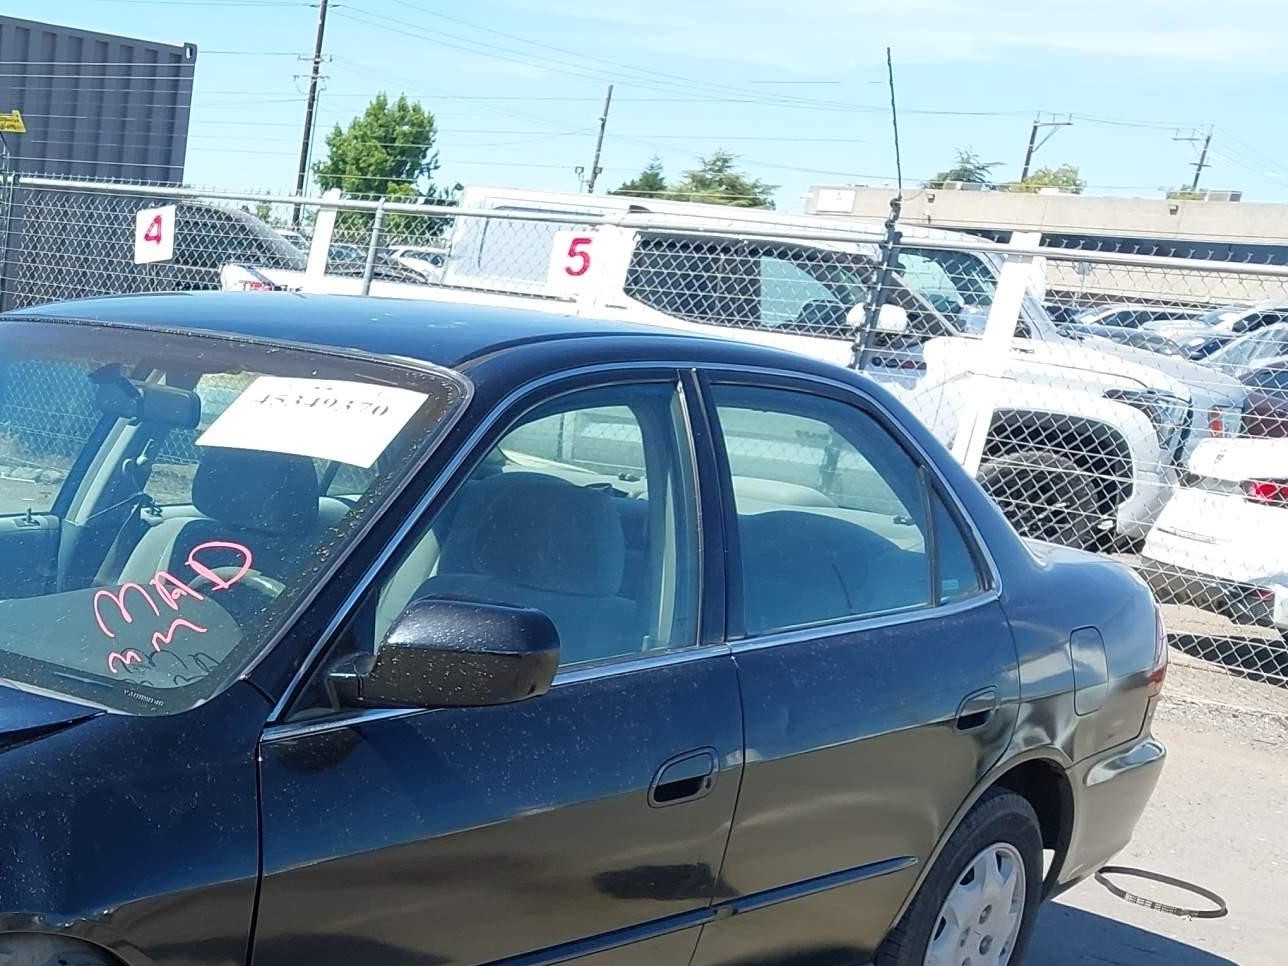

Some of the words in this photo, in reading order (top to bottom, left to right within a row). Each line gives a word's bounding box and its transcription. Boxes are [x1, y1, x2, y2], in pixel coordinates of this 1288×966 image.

[144, 214, 163, 245] 4
[565, 237, 593, 276] 5
[93, 541, 253, 638] MAD
